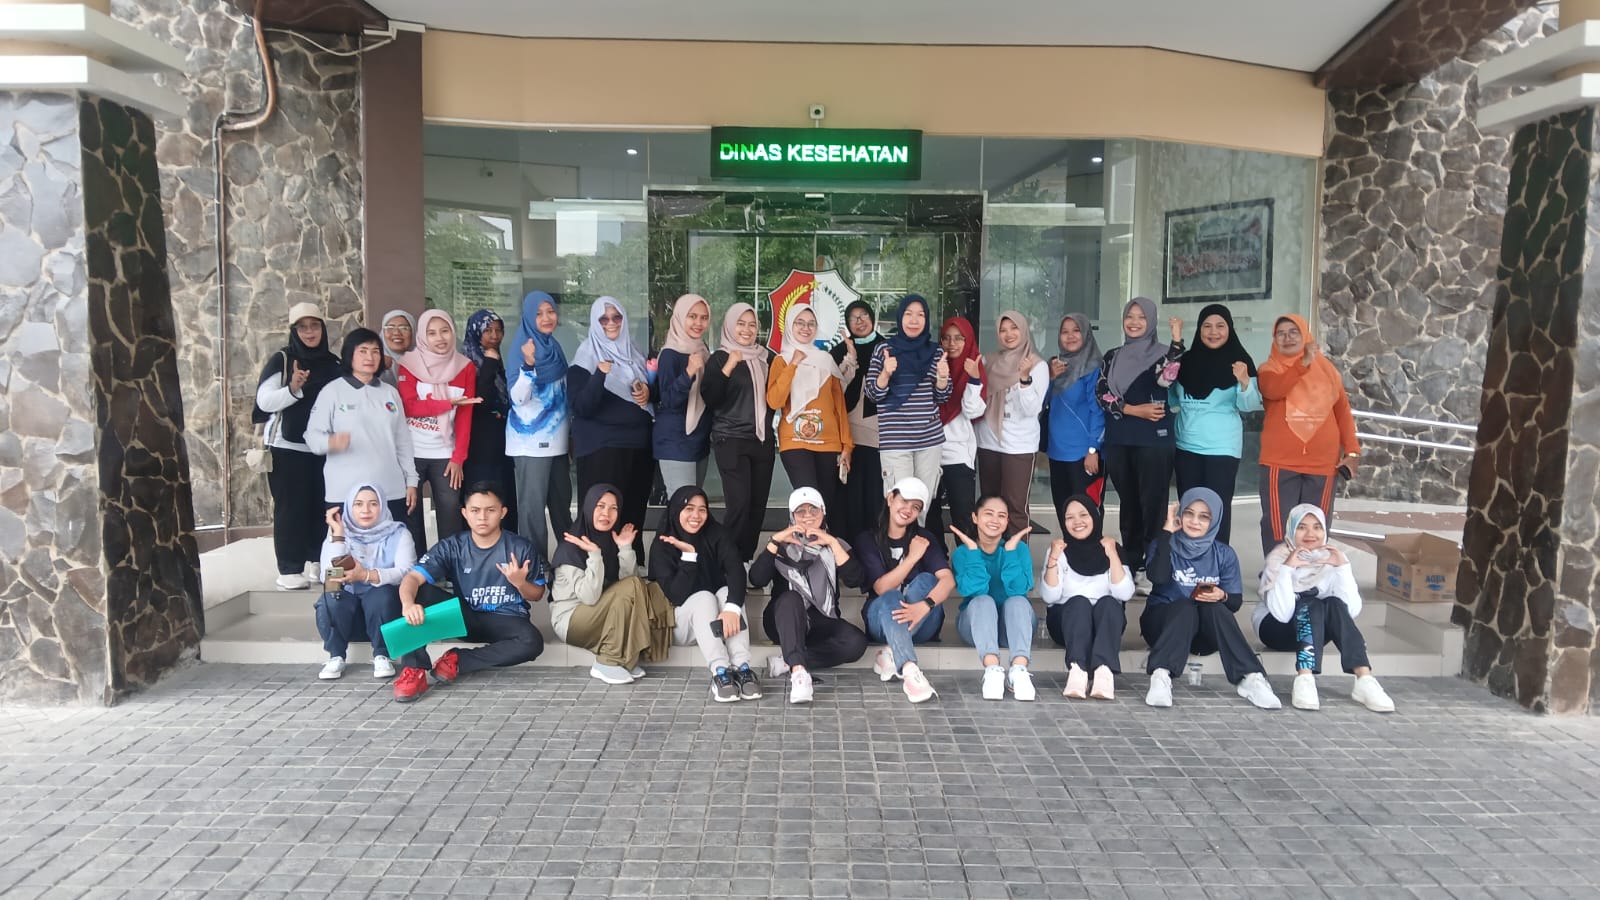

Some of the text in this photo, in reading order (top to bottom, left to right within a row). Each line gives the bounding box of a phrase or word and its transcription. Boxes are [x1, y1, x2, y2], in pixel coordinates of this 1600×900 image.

[719, 143, 908, 163] DINAS KESEHATAN
[406, 418, 441, 431] INDONE
[1425, 574, 1446, 584] AQUA
[472, 586, 507, 598] COFFEE
